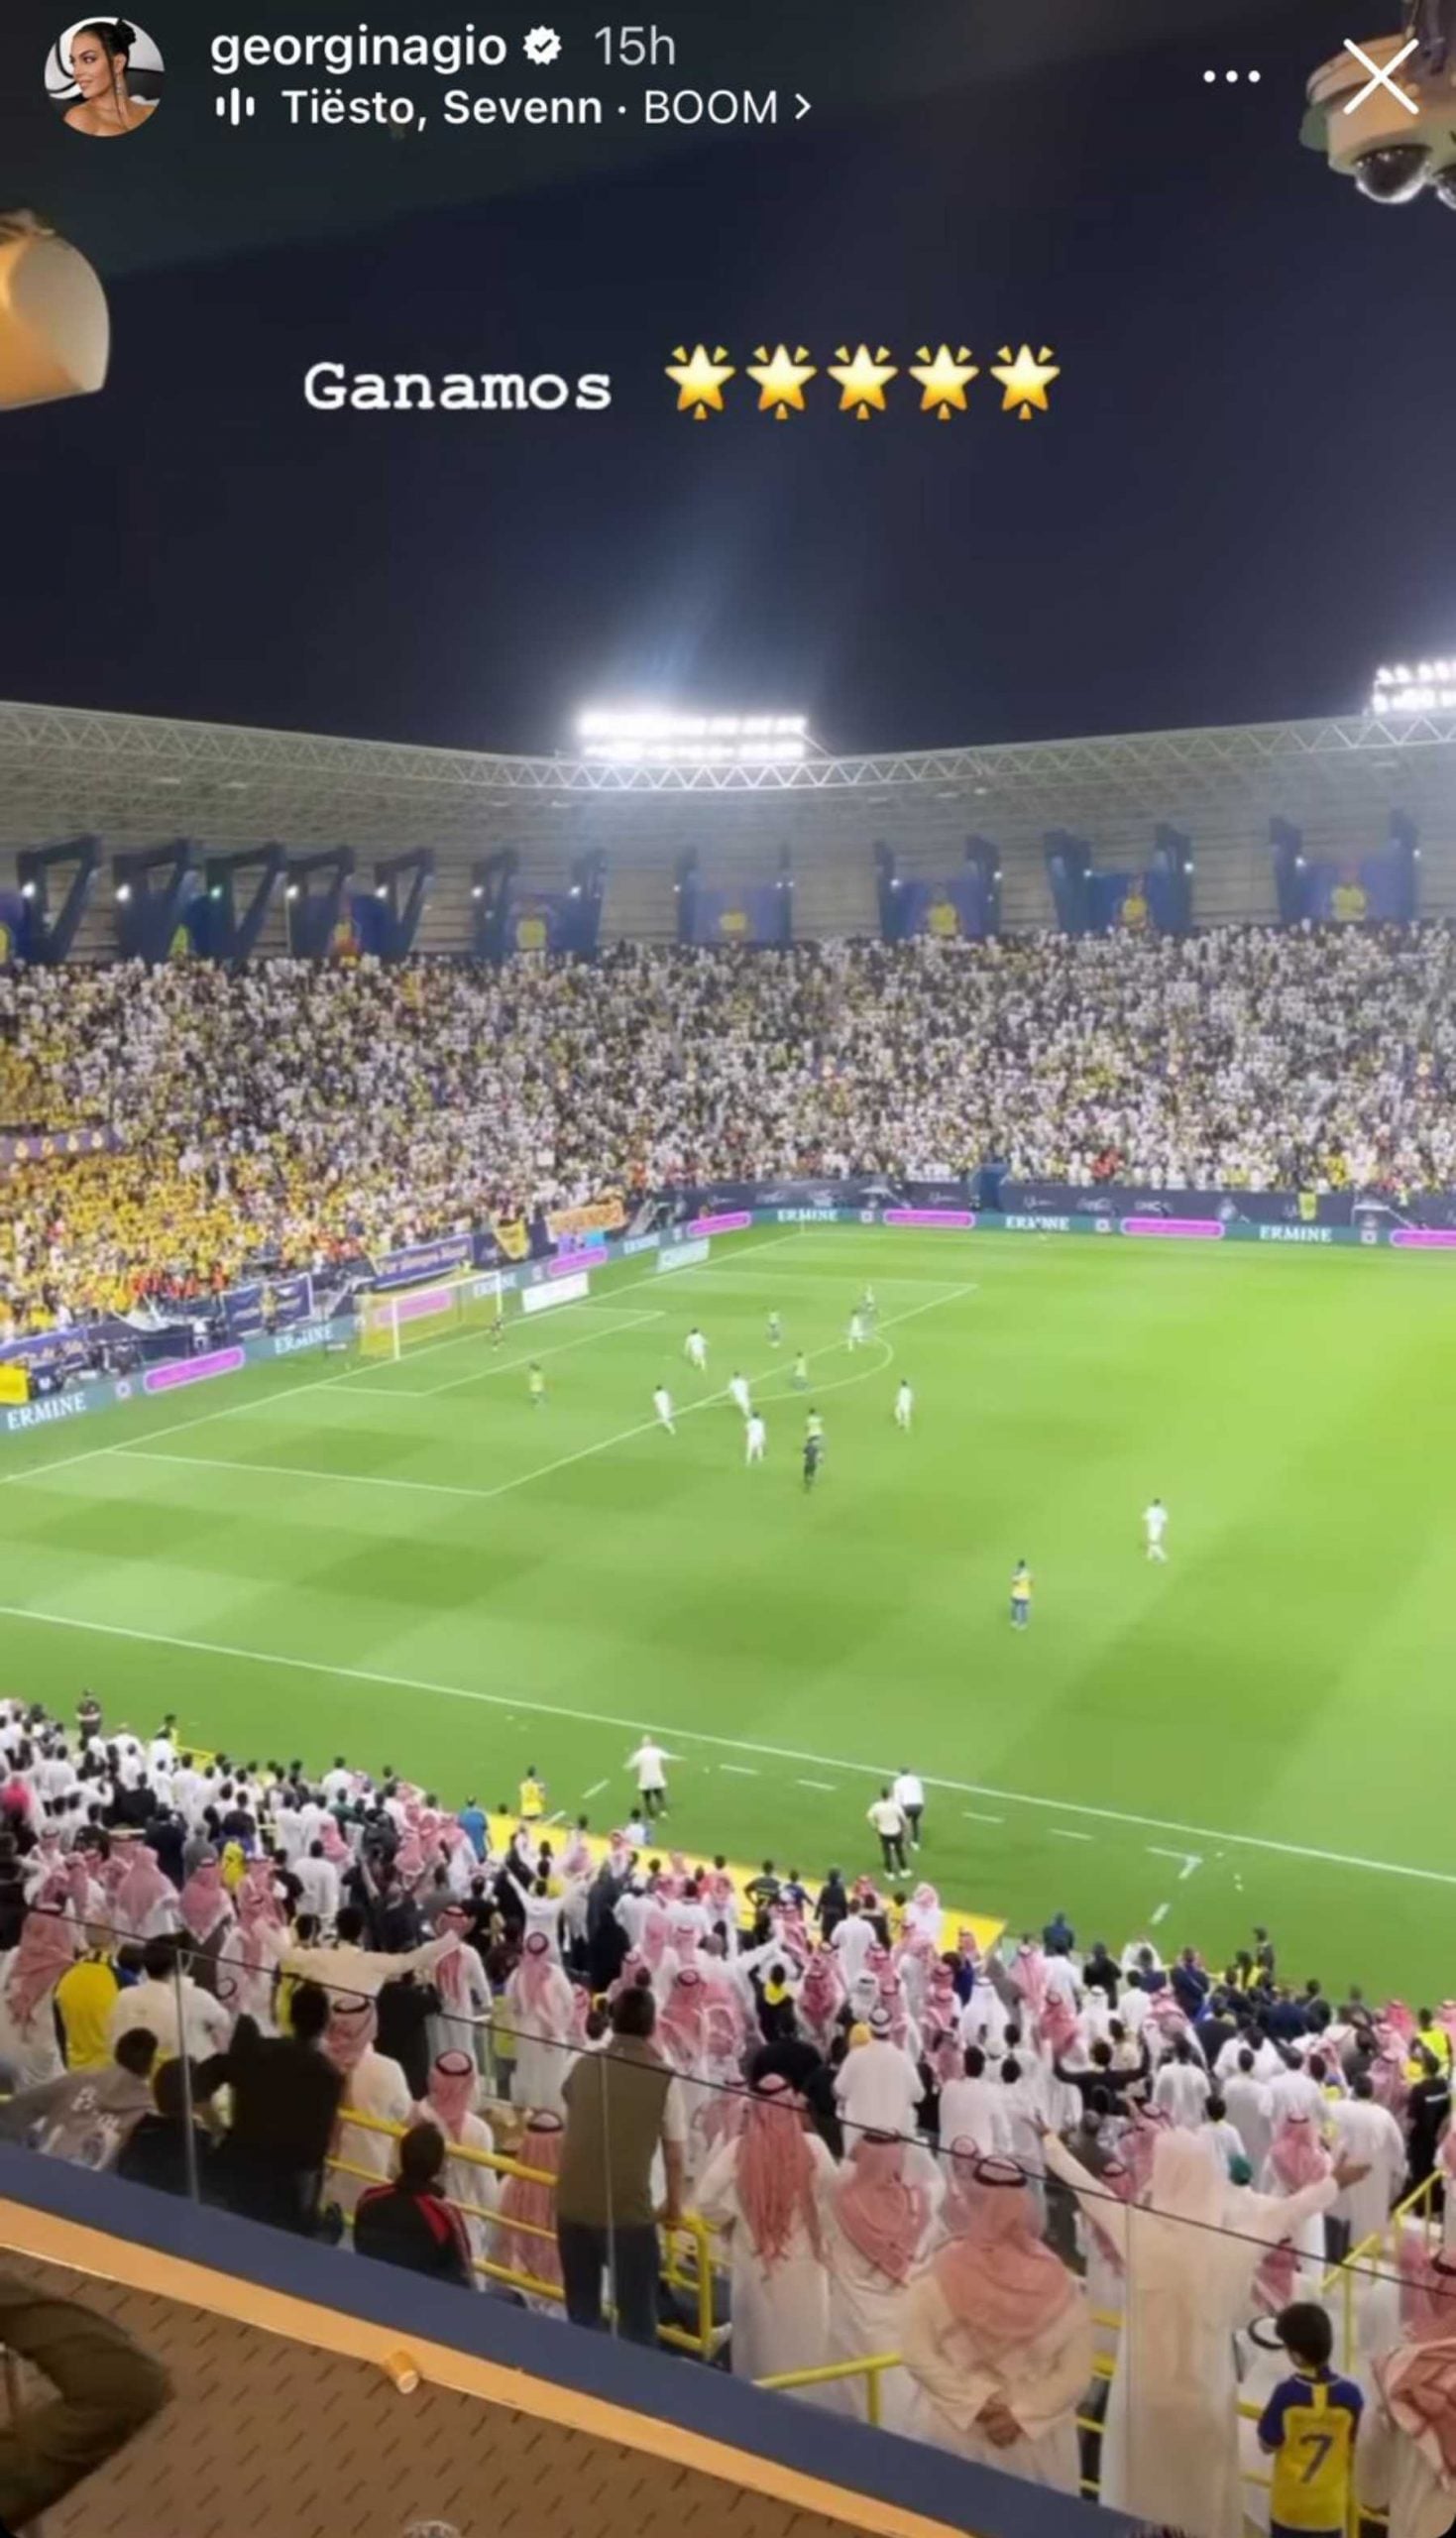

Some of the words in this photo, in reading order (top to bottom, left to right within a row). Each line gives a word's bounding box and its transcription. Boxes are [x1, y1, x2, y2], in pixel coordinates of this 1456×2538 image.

[777, 1208, 839, 1222] ERMINE
[1259, 1224, 1332, 1243] ERMINE
[7, 1391, 87, 1431] ERMINE
[1298, 2433, 1334, 2483] 7
